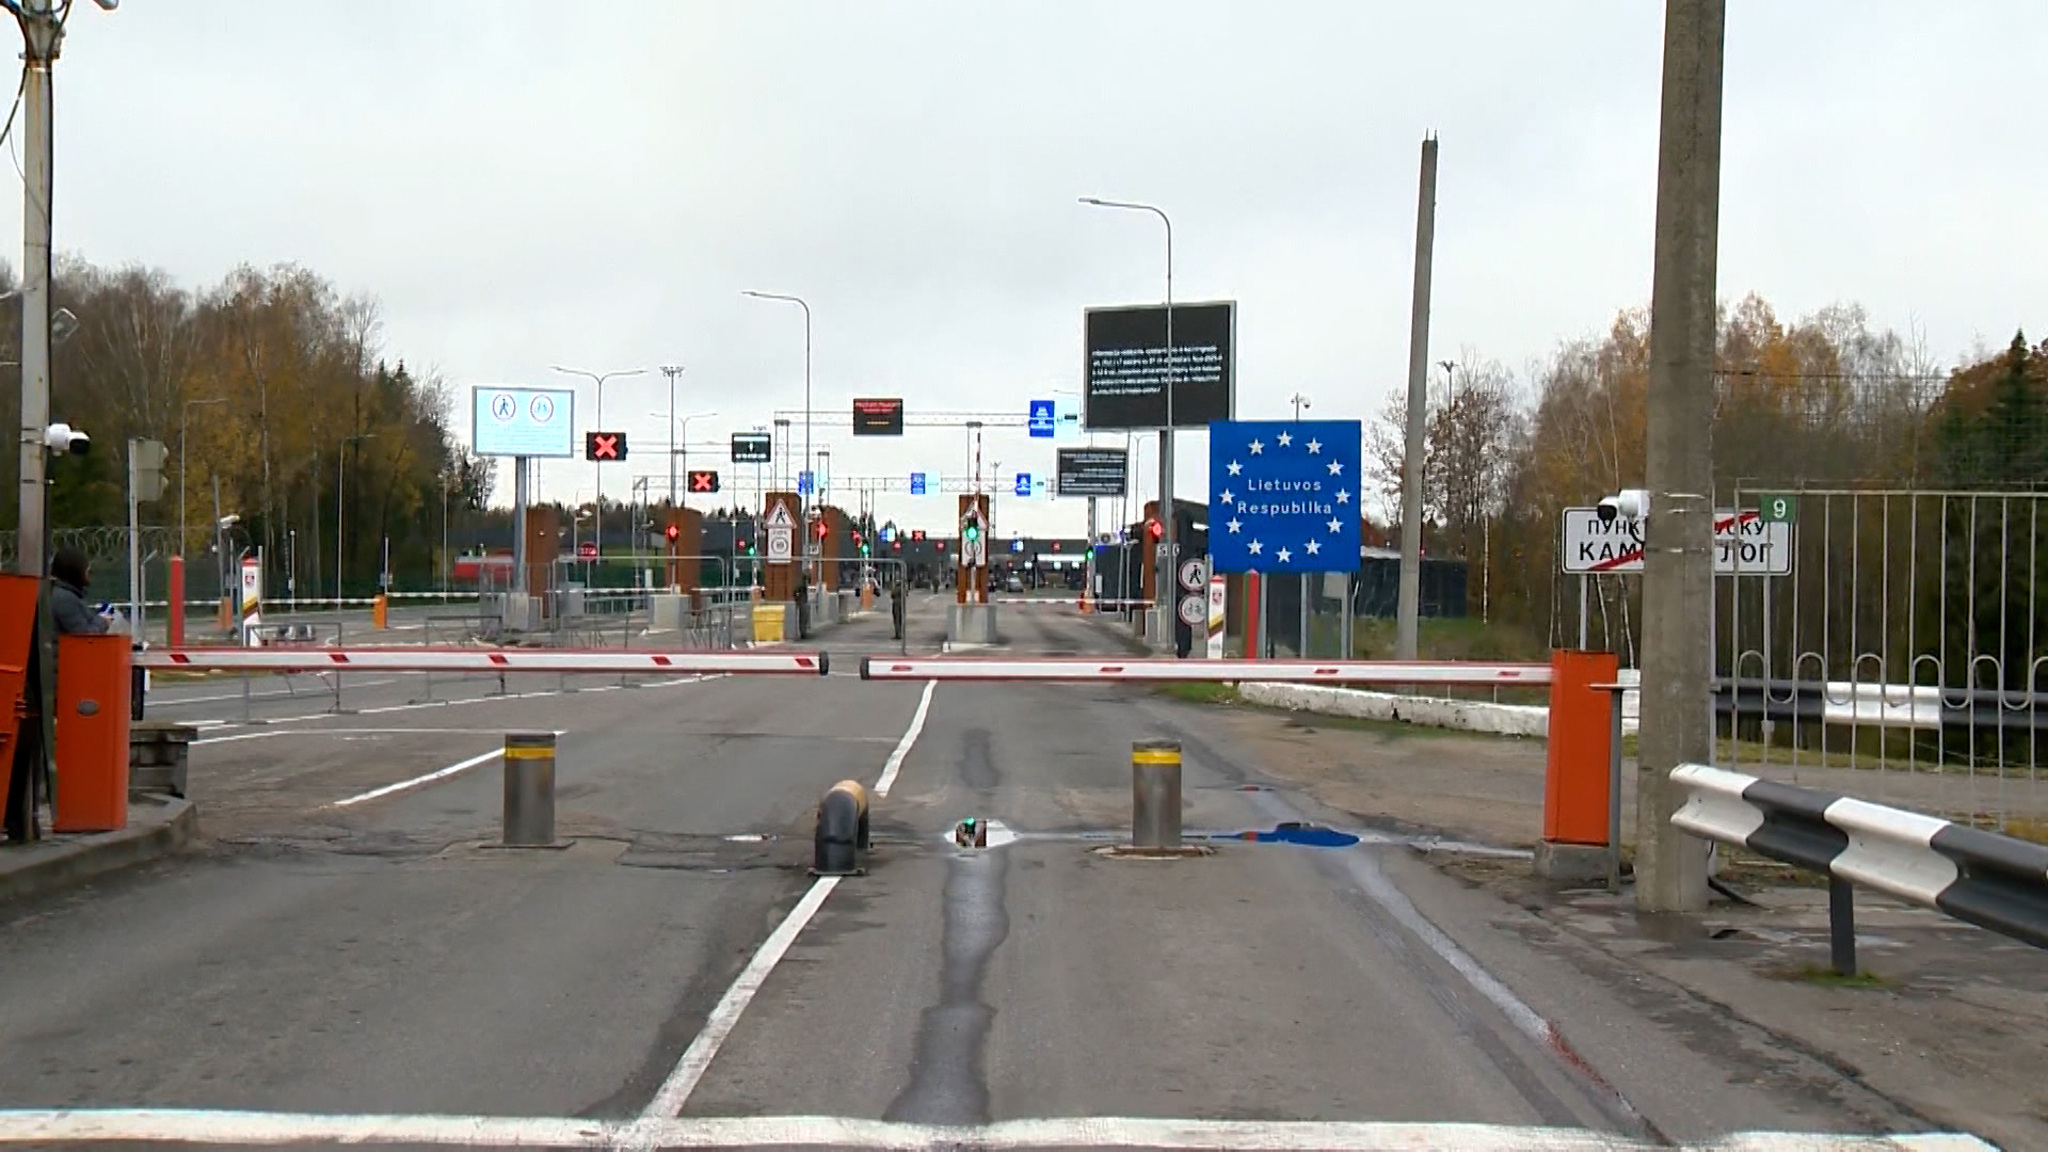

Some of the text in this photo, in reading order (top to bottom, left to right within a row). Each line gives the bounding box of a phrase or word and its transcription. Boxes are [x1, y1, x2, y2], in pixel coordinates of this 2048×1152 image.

[1248, 478, 1322, 491] Lietuvos
[1237, 501, 1332, 517] Respublika
[1773, 499, 1786, 518] 9
[1587, 518, 1641, 535] ПУНК
[1580, 541, 1645, 561] КАМ
